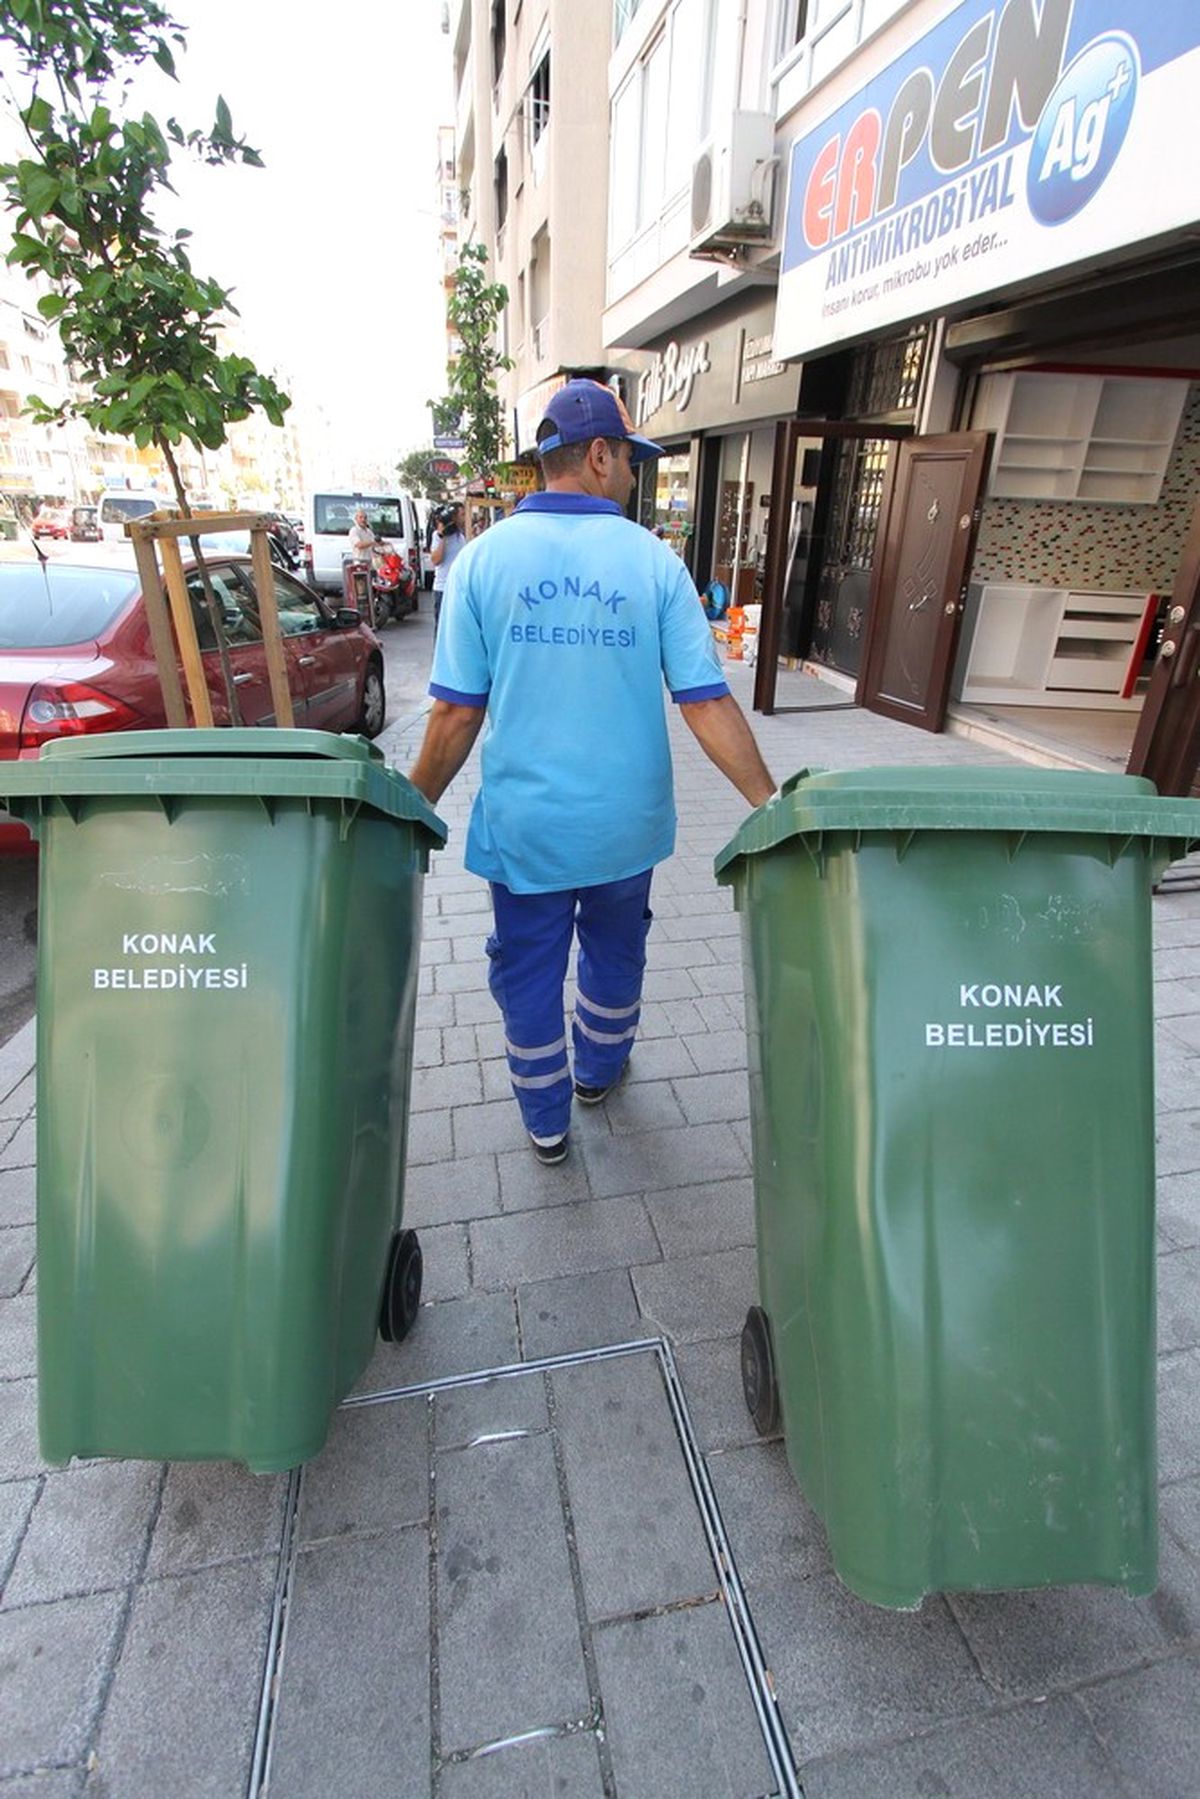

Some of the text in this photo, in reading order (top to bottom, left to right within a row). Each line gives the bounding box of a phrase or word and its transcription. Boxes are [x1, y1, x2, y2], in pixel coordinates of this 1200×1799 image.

[803, 0, 1070, 248] ERPEN
[850, 282, 880, 307] korur,
[882, 259, 931, 292] mikrobu
[932, 246, 959, 279] yok
[518, 576, 627, 614] KONAK
[511, 624, 636, 648] BELEDİYESİ
[122, 933, 217, 954] KONAK
[93, 963, 248, 989] BELEDİYESİ
[959, 984, 1063, 1007] KONAK
[925, 1017, 1094, 1047] BELEDİYESİ
